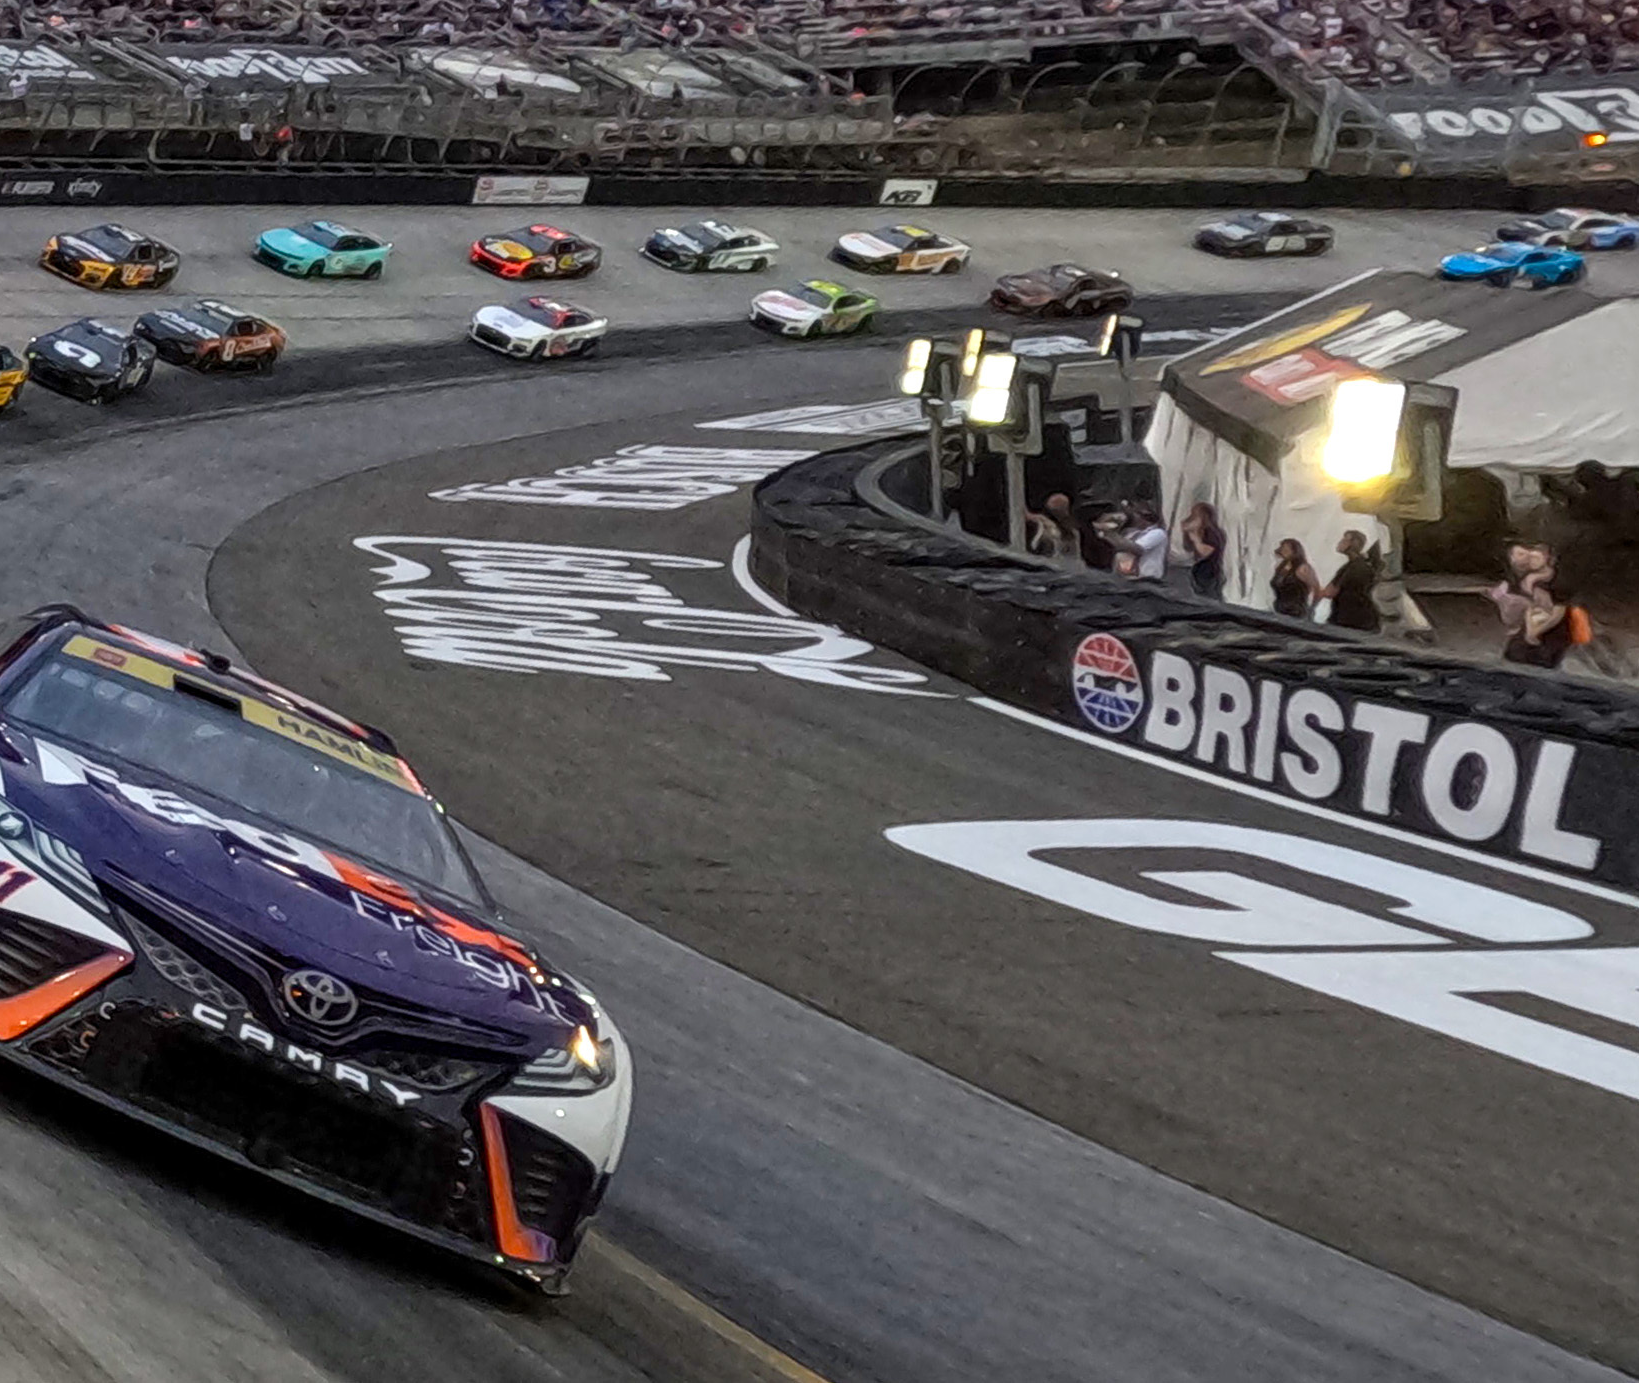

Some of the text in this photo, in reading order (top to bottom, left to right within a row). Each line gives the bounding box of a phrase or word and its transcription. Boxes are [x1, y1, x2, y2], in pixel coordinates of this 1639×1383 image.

[1142, 650, 1602, 871] BRISTOL
[350, 889, 576, 1027] Freight
[191, 1002, 421, 1107] CAMRY
